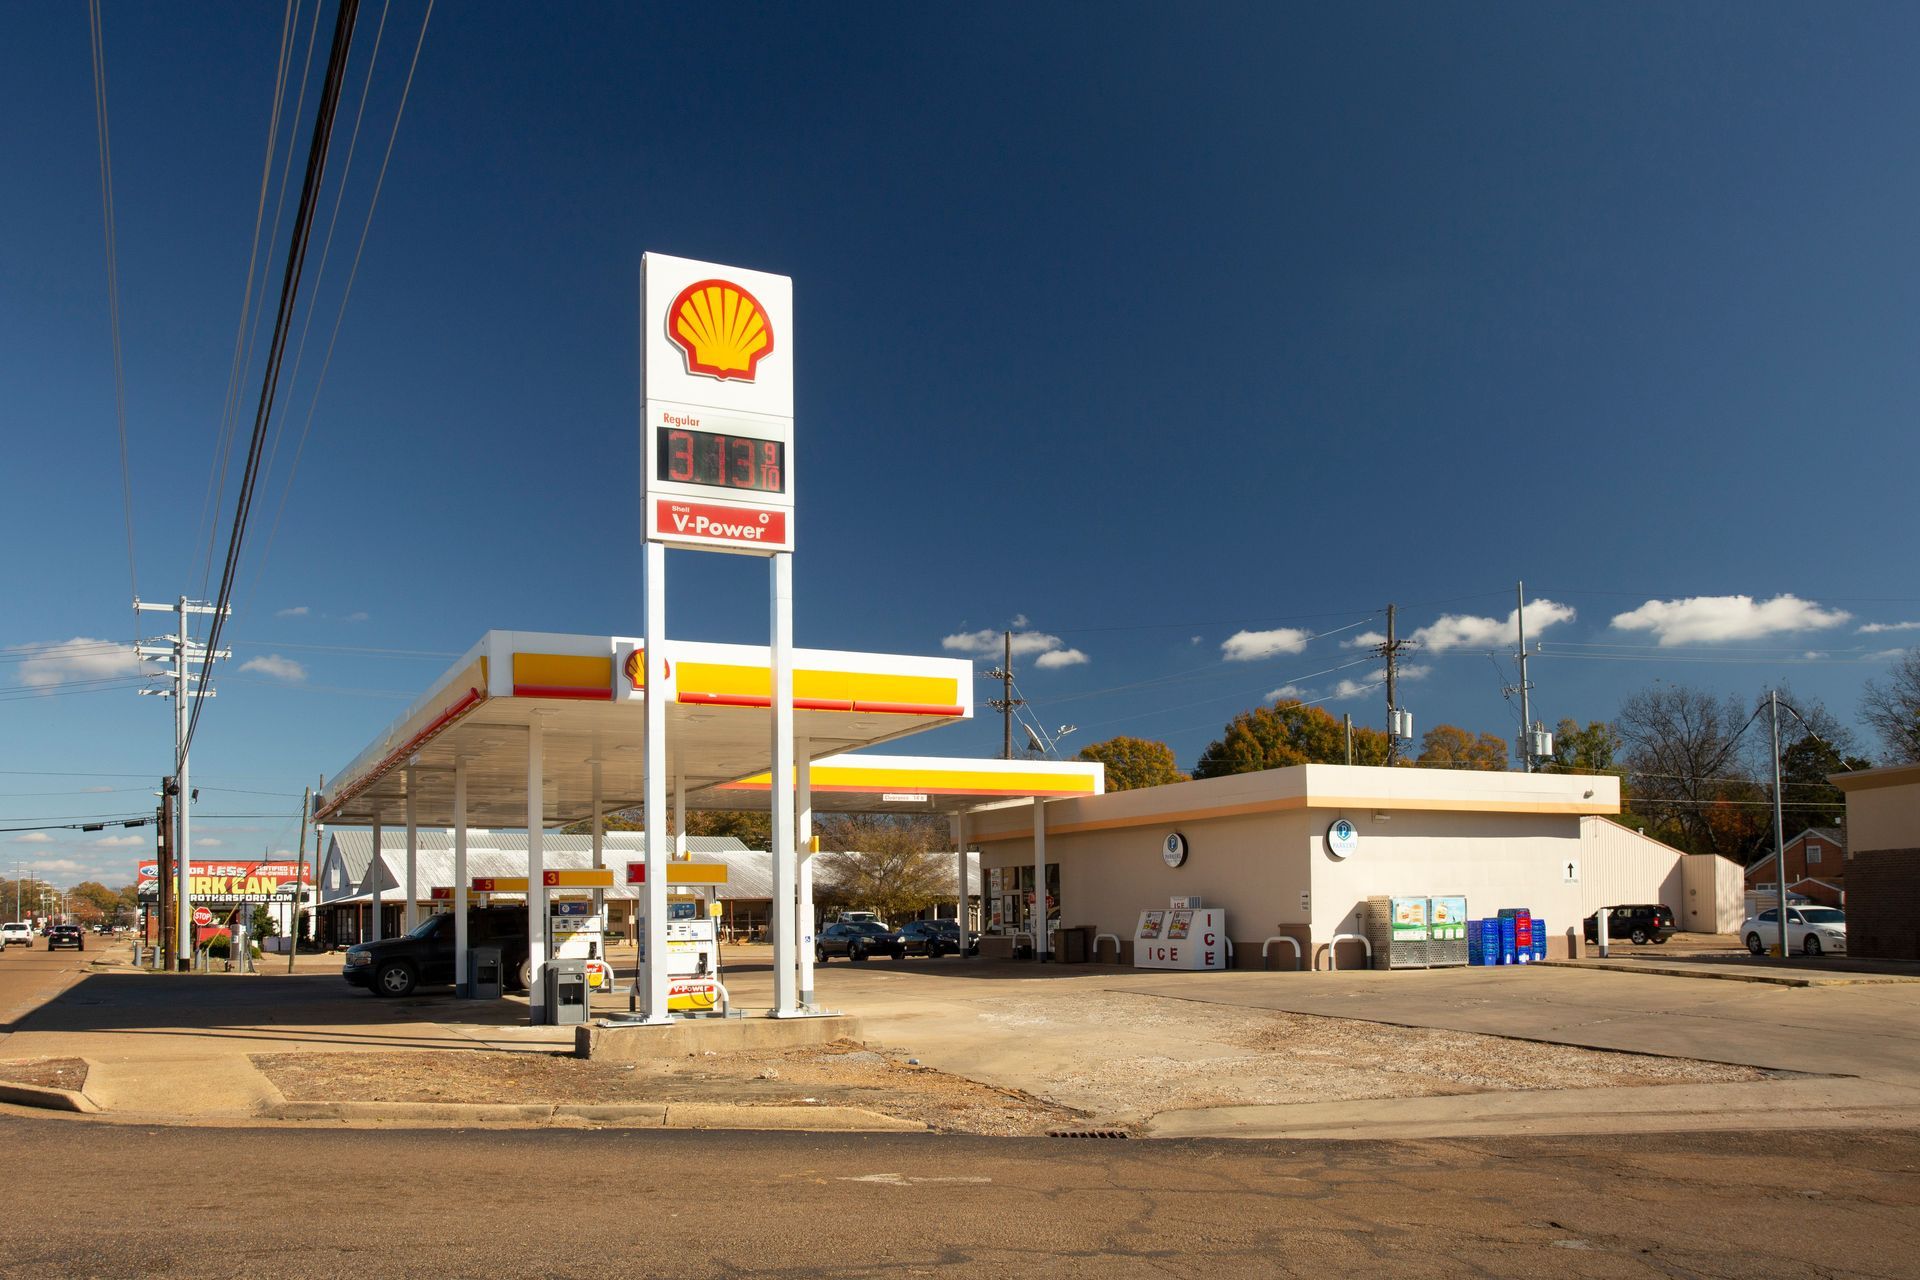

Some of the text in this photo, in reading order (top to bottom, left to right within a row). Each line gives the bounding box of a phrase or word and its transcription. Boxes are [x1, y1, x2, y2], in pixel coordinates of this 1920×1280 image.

[663, 412, 700, 427] Regular
[672, 505, 690, 513] Shell
[672, 513, 766, 540] V-Power
[188, 865, 247, 877] OR LESS
[484, 879, 492, 889] 5
[548, 872, 557, 884] 3
[173, 876, 277, 895] IRK CAN
[441, 889, 449, 897] 7
[194, 912, 211, 920] STOP
[1203, 913, 1215, 966] ICE
[1148, 946, 1178, 961] ICE
